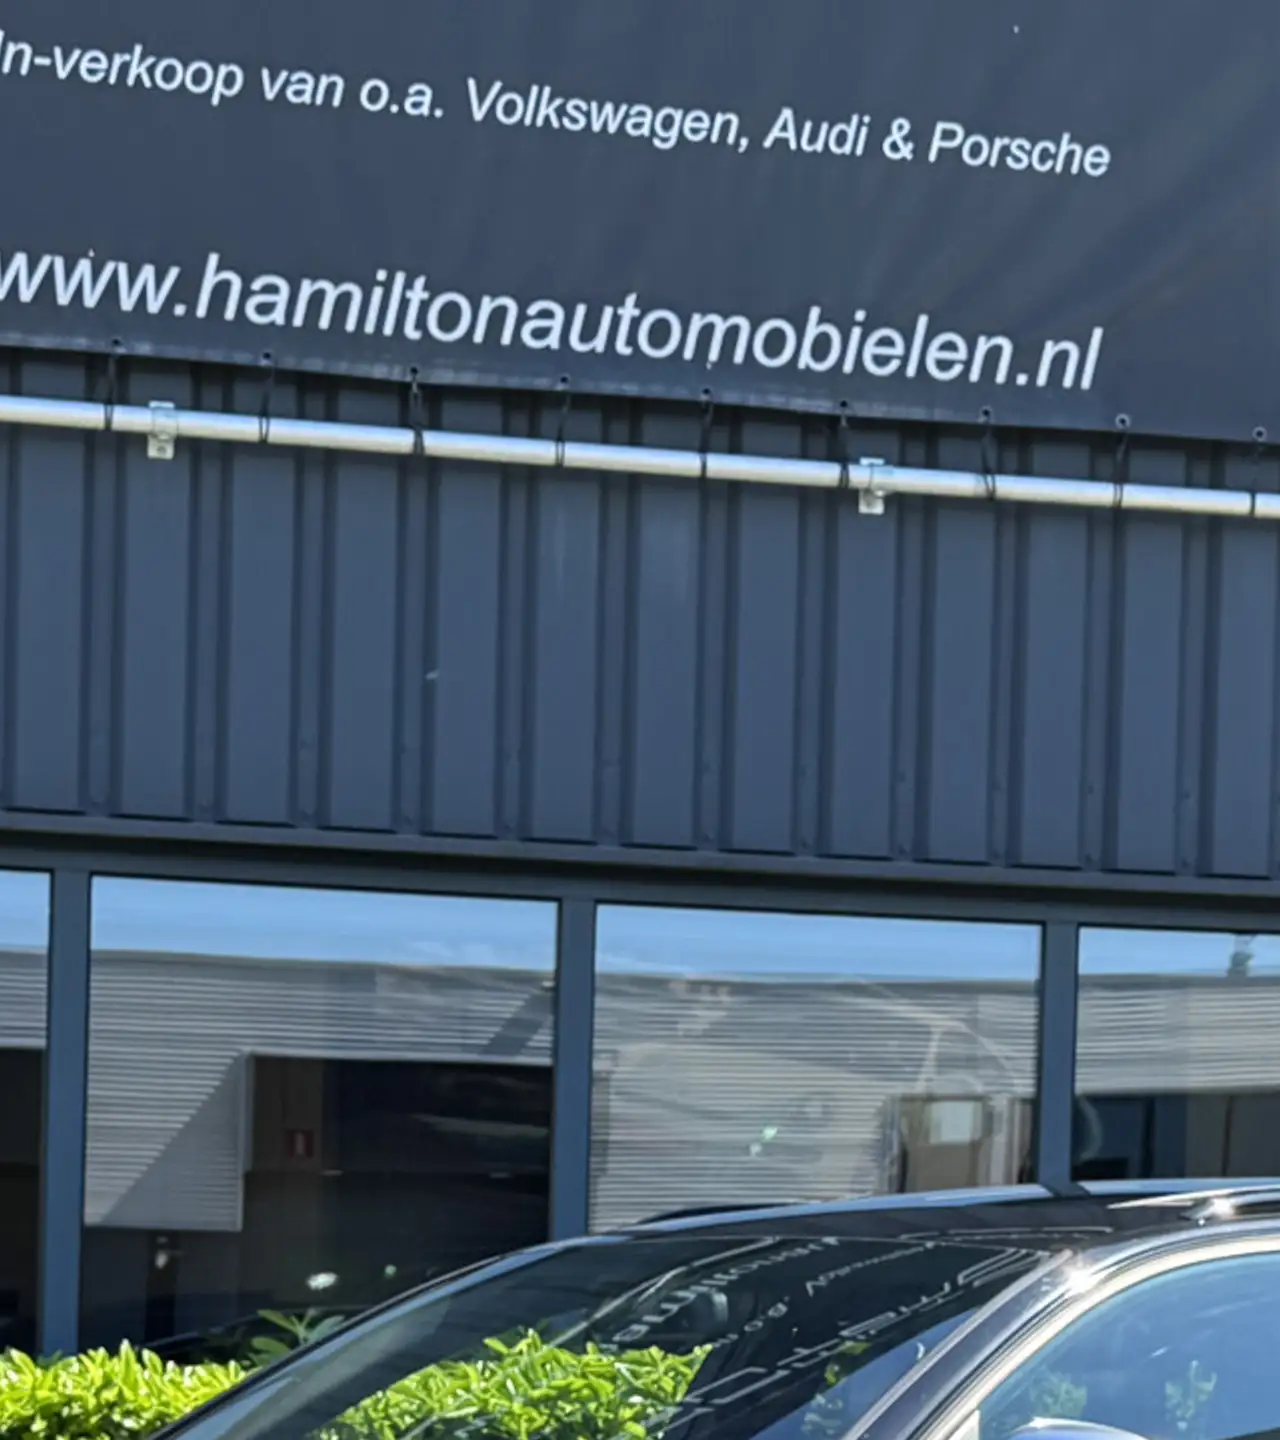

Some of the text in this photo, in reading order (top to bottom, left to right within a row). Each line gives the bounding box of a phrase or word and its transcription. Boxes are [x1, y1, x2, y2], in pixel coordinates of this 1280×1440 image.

[261, 67, 345, 108] van
[359, 78, 444, 118] o.a.
[467, 77, 749, 154] Volkswagen,
[762, 107, 871, 157] Audi
[882, 117, 914, 161] &
[927, 120, 1111, 177] Porsche
